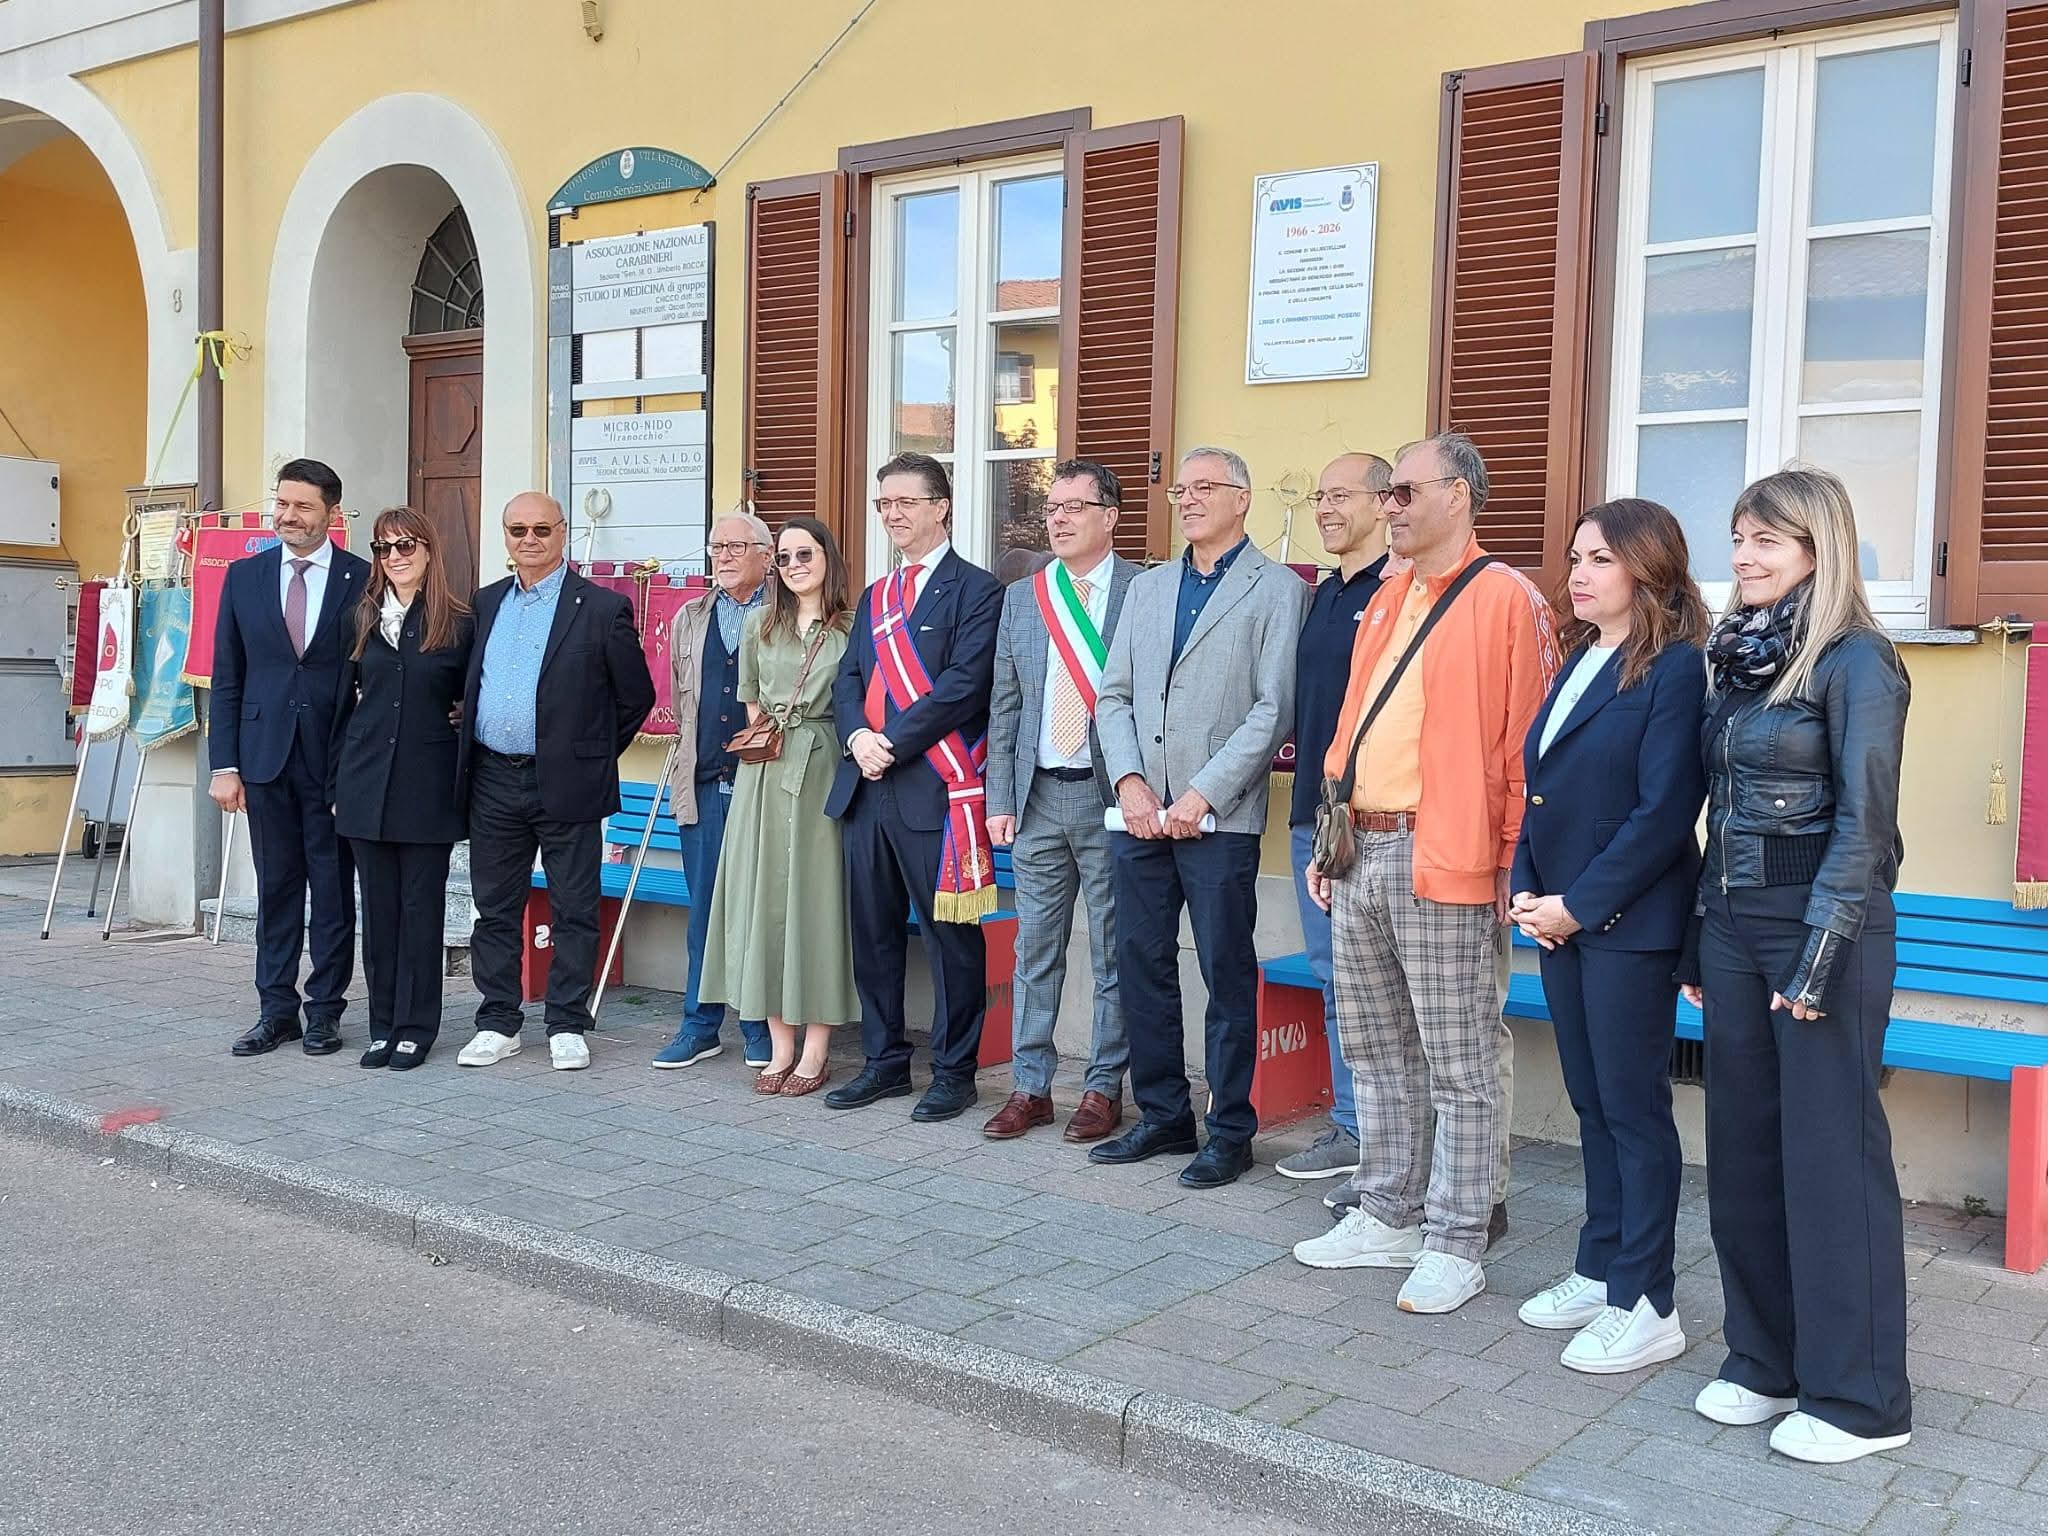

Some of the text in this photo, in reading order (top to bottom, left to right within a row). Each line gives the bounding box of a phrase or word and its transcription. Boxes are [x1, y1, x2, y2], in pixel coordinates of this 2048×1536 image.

[564, 151, 701, 195] COMUNE DI VILLASTELLONE
[584, 178, 671, 201] Centro Servizi Sociali
[1269, 197, 1302, 212] AVIS
[1286, 225, 1308, 238] 1966
[1317, 223, 1341, 235] 2026
[585, 233, 705, 260] ASSOCIAZIONE NAZIONALE
[616, 251, 673, 268] CARABINIERI
[578, 290, 610, 304] STUDIO
[612, 288, 621, 299] DI
[623, 284, 665, 298] MEDICINA
[667, 281, 675, 292] di
[677, 280, 706, 294] gruppo
[656, 293, 679, 304] CHICCO
[603, 419, 673, 433] MICRO-NIDO
[578, 456, 597, 465] AVIS
[200, 557, 235, 568] ASSOCIA
